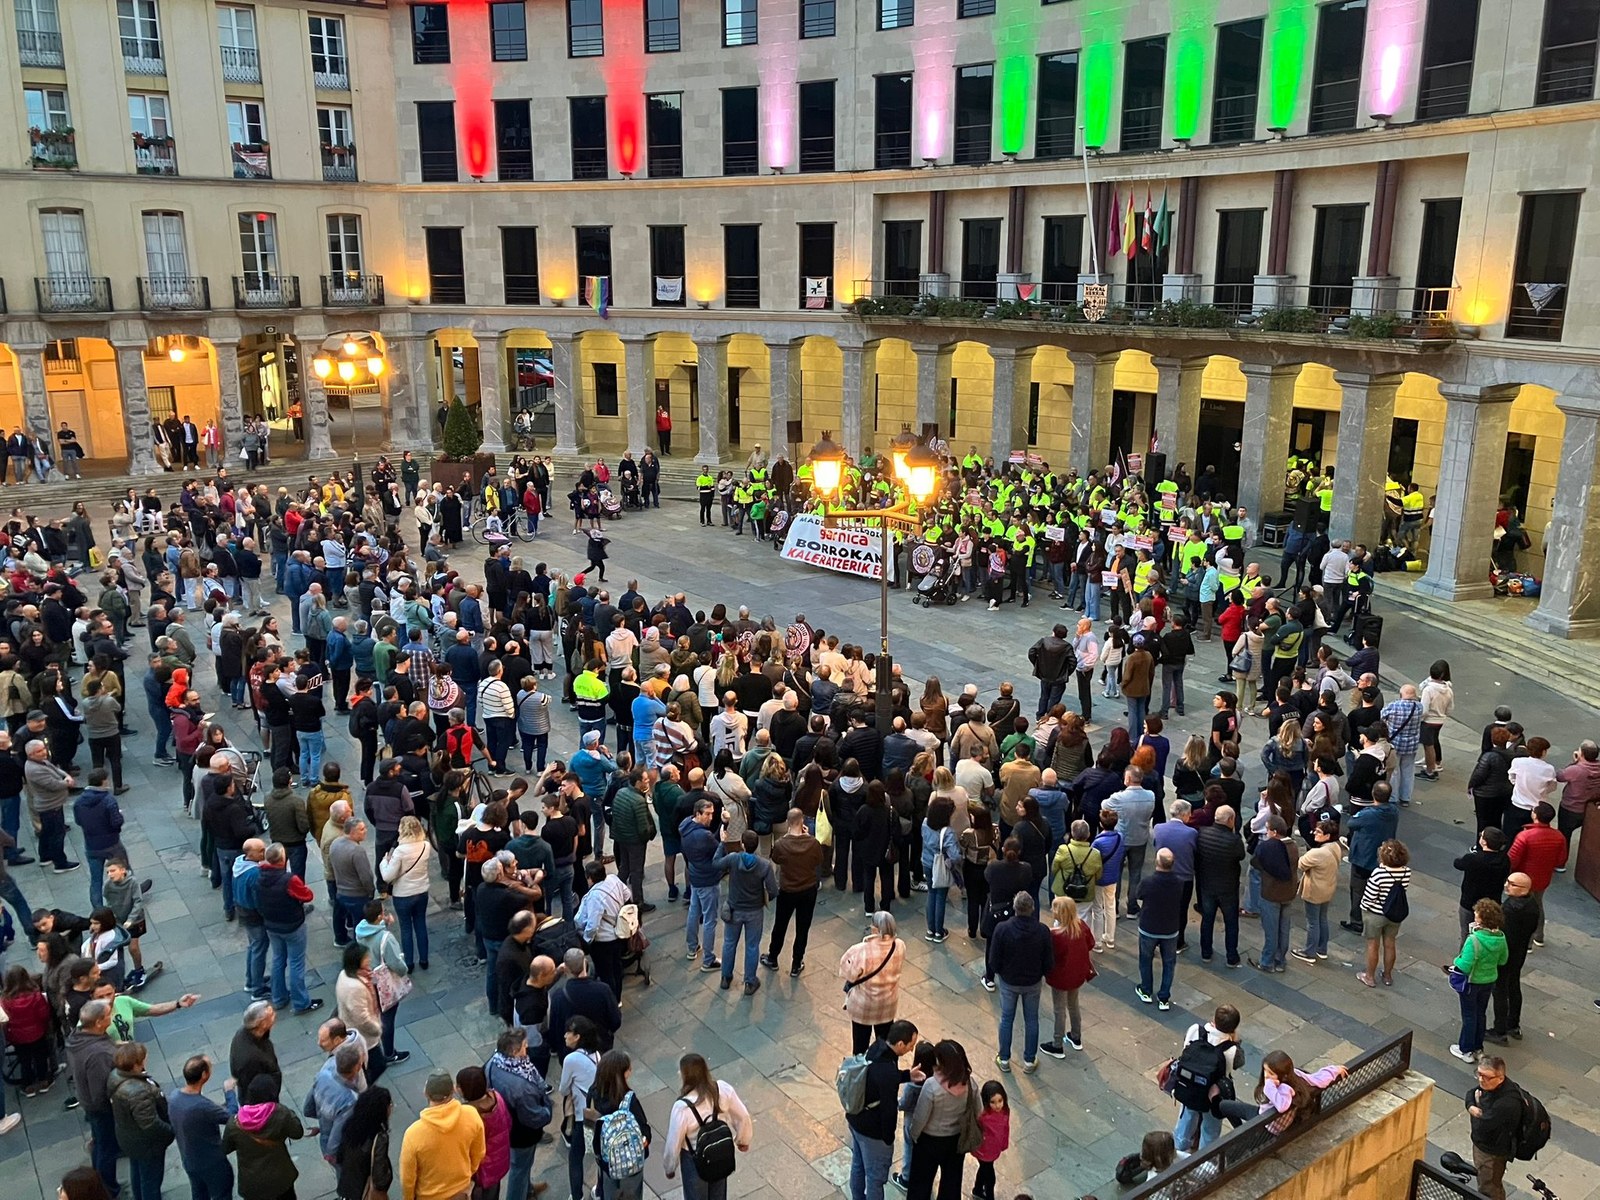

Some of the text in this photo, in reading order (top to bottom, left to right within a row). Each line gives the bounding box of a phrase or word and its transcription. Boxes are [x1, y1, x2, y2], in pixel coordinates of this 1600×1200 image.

[820, 529, 868, 546] garnica
[788, 547, 871, 574] KALERATZERIK
[796, 538, 883, 564] BORROKAN
